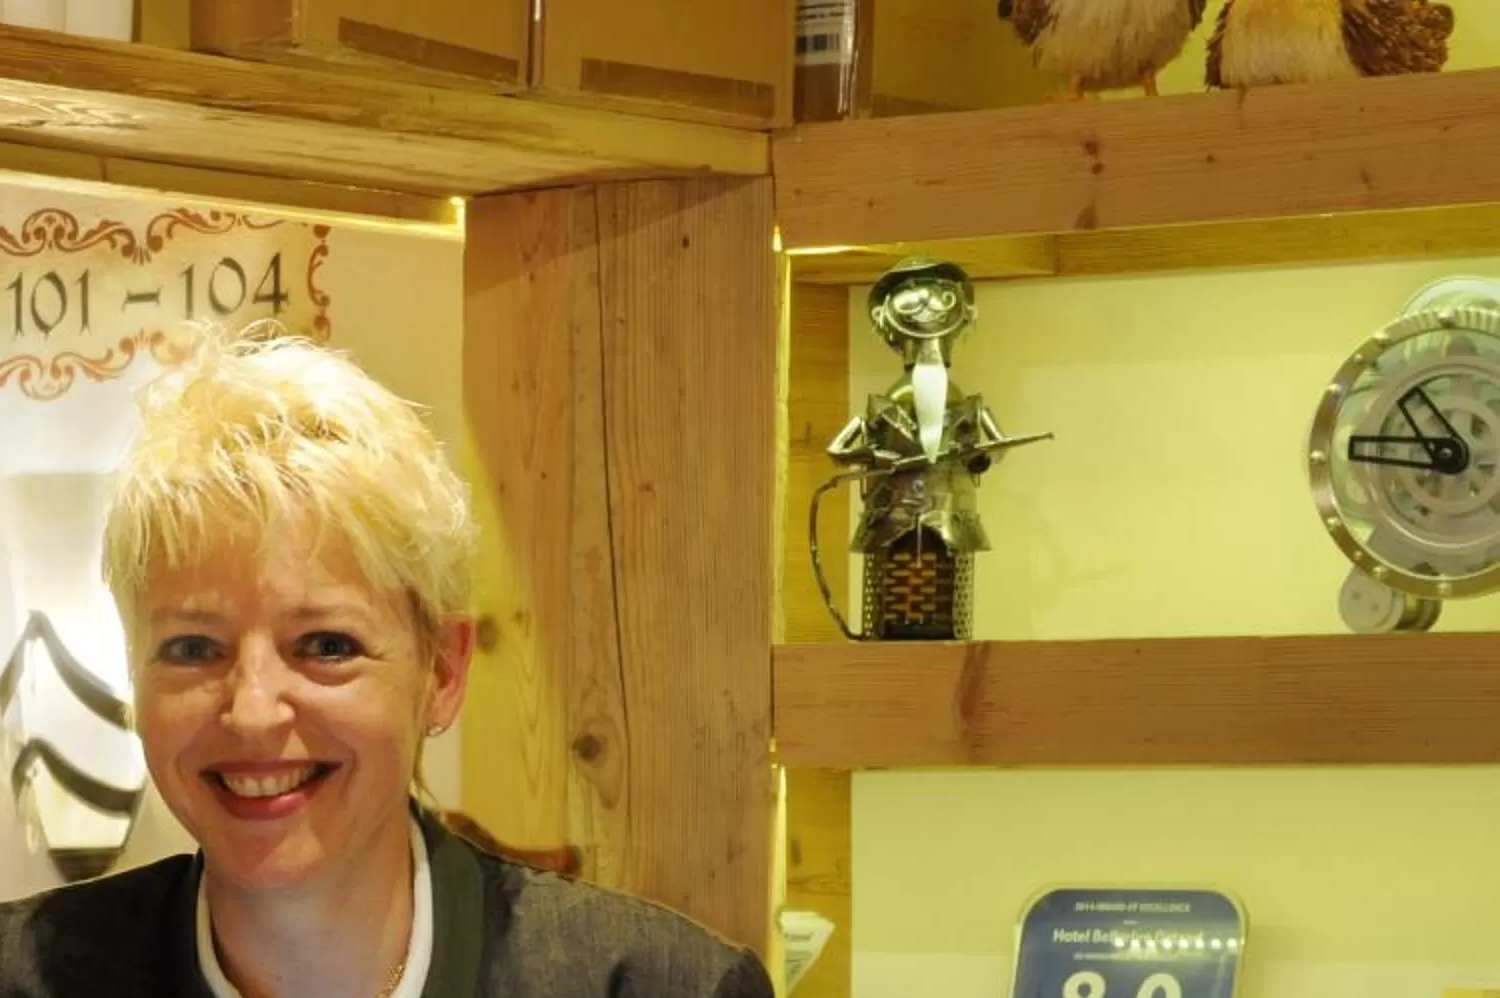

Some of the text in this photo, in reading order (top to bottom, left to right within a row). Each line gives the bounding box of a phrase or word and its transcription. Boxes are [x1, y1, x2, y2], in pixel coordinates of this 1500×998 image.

[6, 268, 92, 341] 101
[179, 252, 291, 321] 104
[1051, 927, 1091, 944] Hotel
